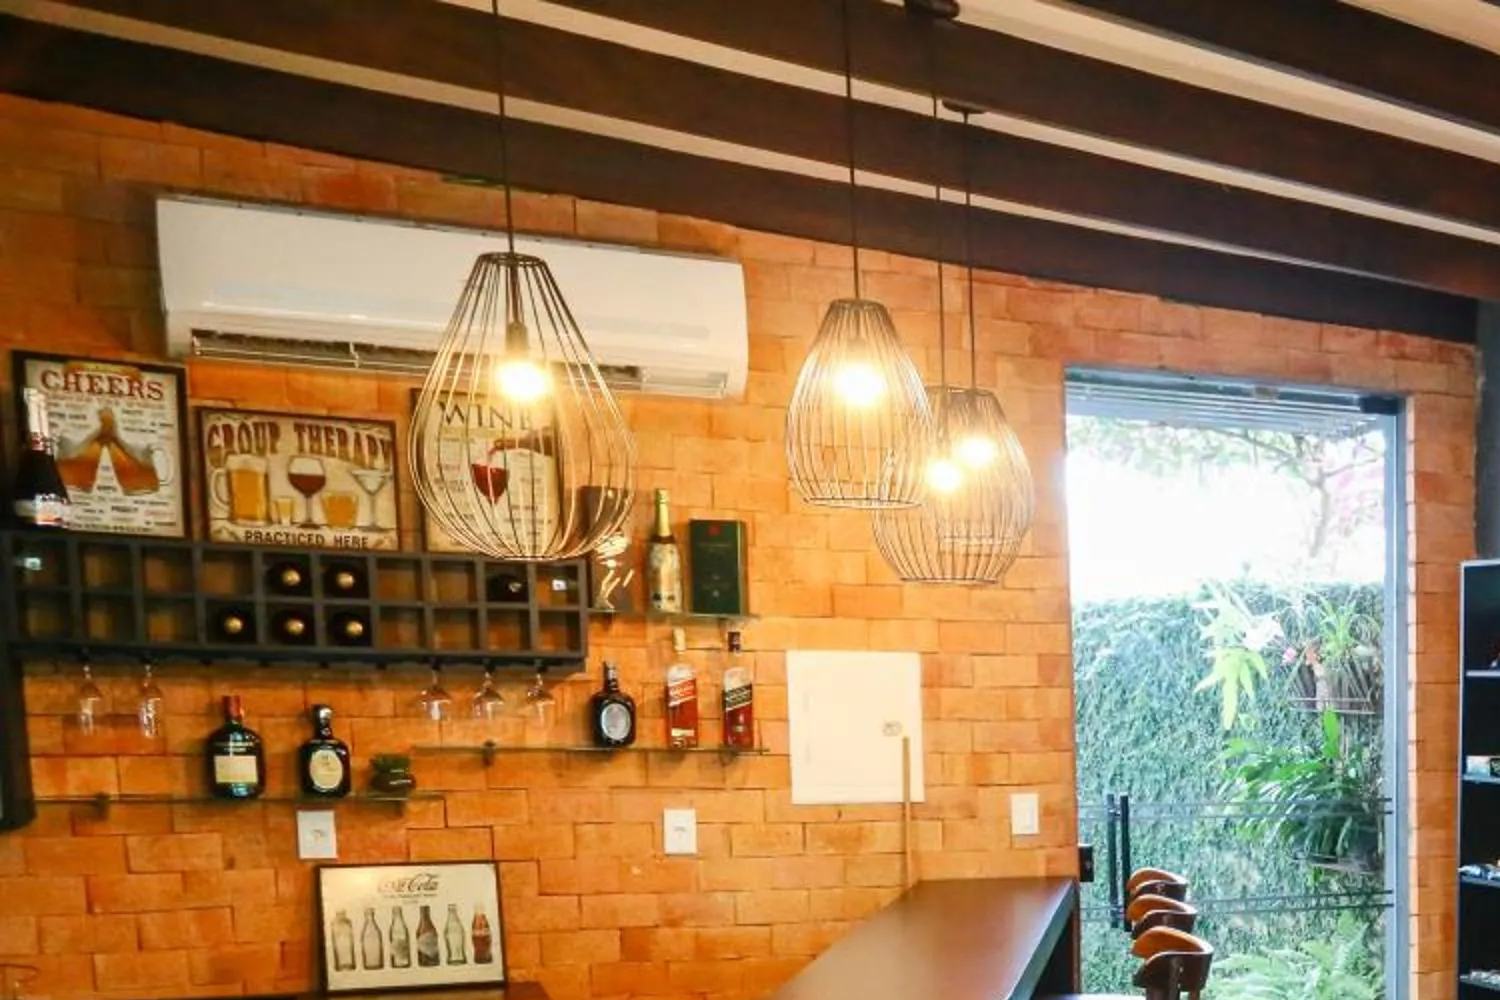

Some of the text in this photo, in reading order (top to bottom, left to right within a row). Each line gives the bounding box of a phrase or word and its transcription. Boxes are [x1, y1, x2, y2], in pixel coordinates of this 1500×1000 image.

[41, 369, 165, 401] CHEERS
[438, 401, 534, 430] WINE
[207, 420, 393, 470] GROUP THERAPY
[243, 529, 369, 550] PRACTICED HERE
